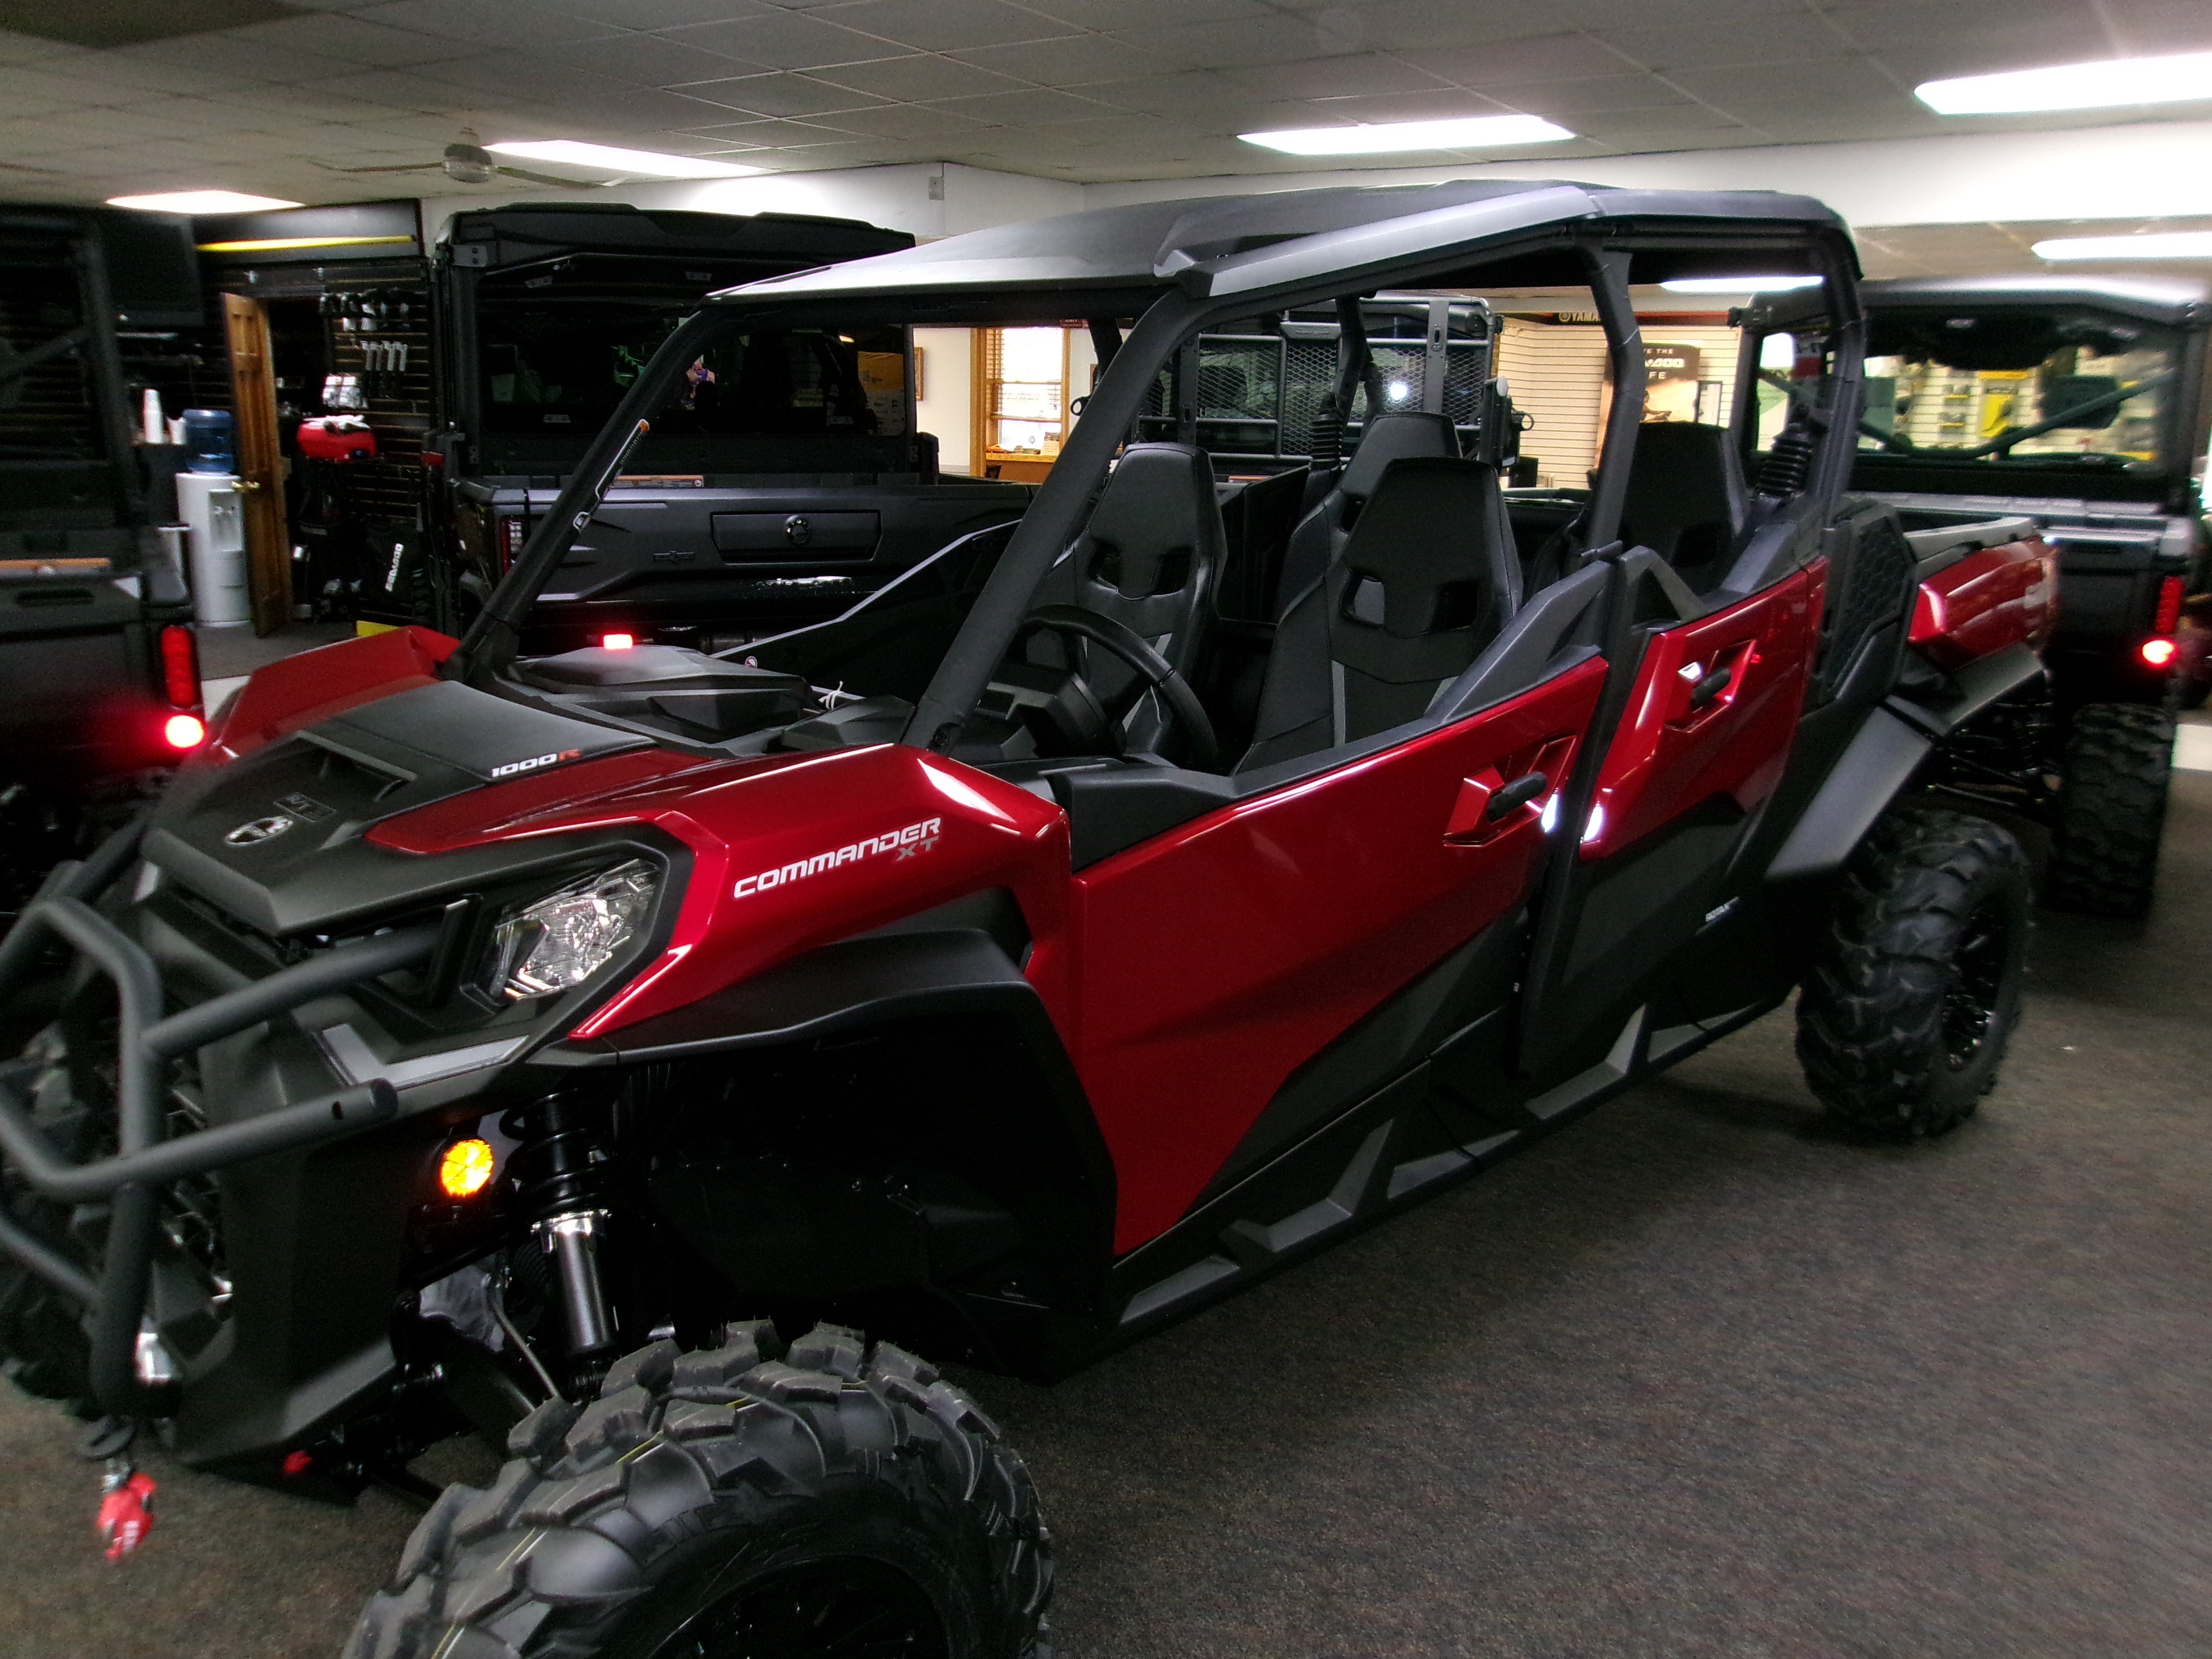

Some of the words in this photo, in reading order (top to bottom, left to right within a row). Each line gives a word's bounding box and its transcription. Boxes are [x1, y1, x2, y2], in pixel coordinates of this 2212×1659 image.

[492, 748, 582, 778] 1000R
[733, 817, 942, 899] COMMANDER
[895, 835, 939, 862] XT
